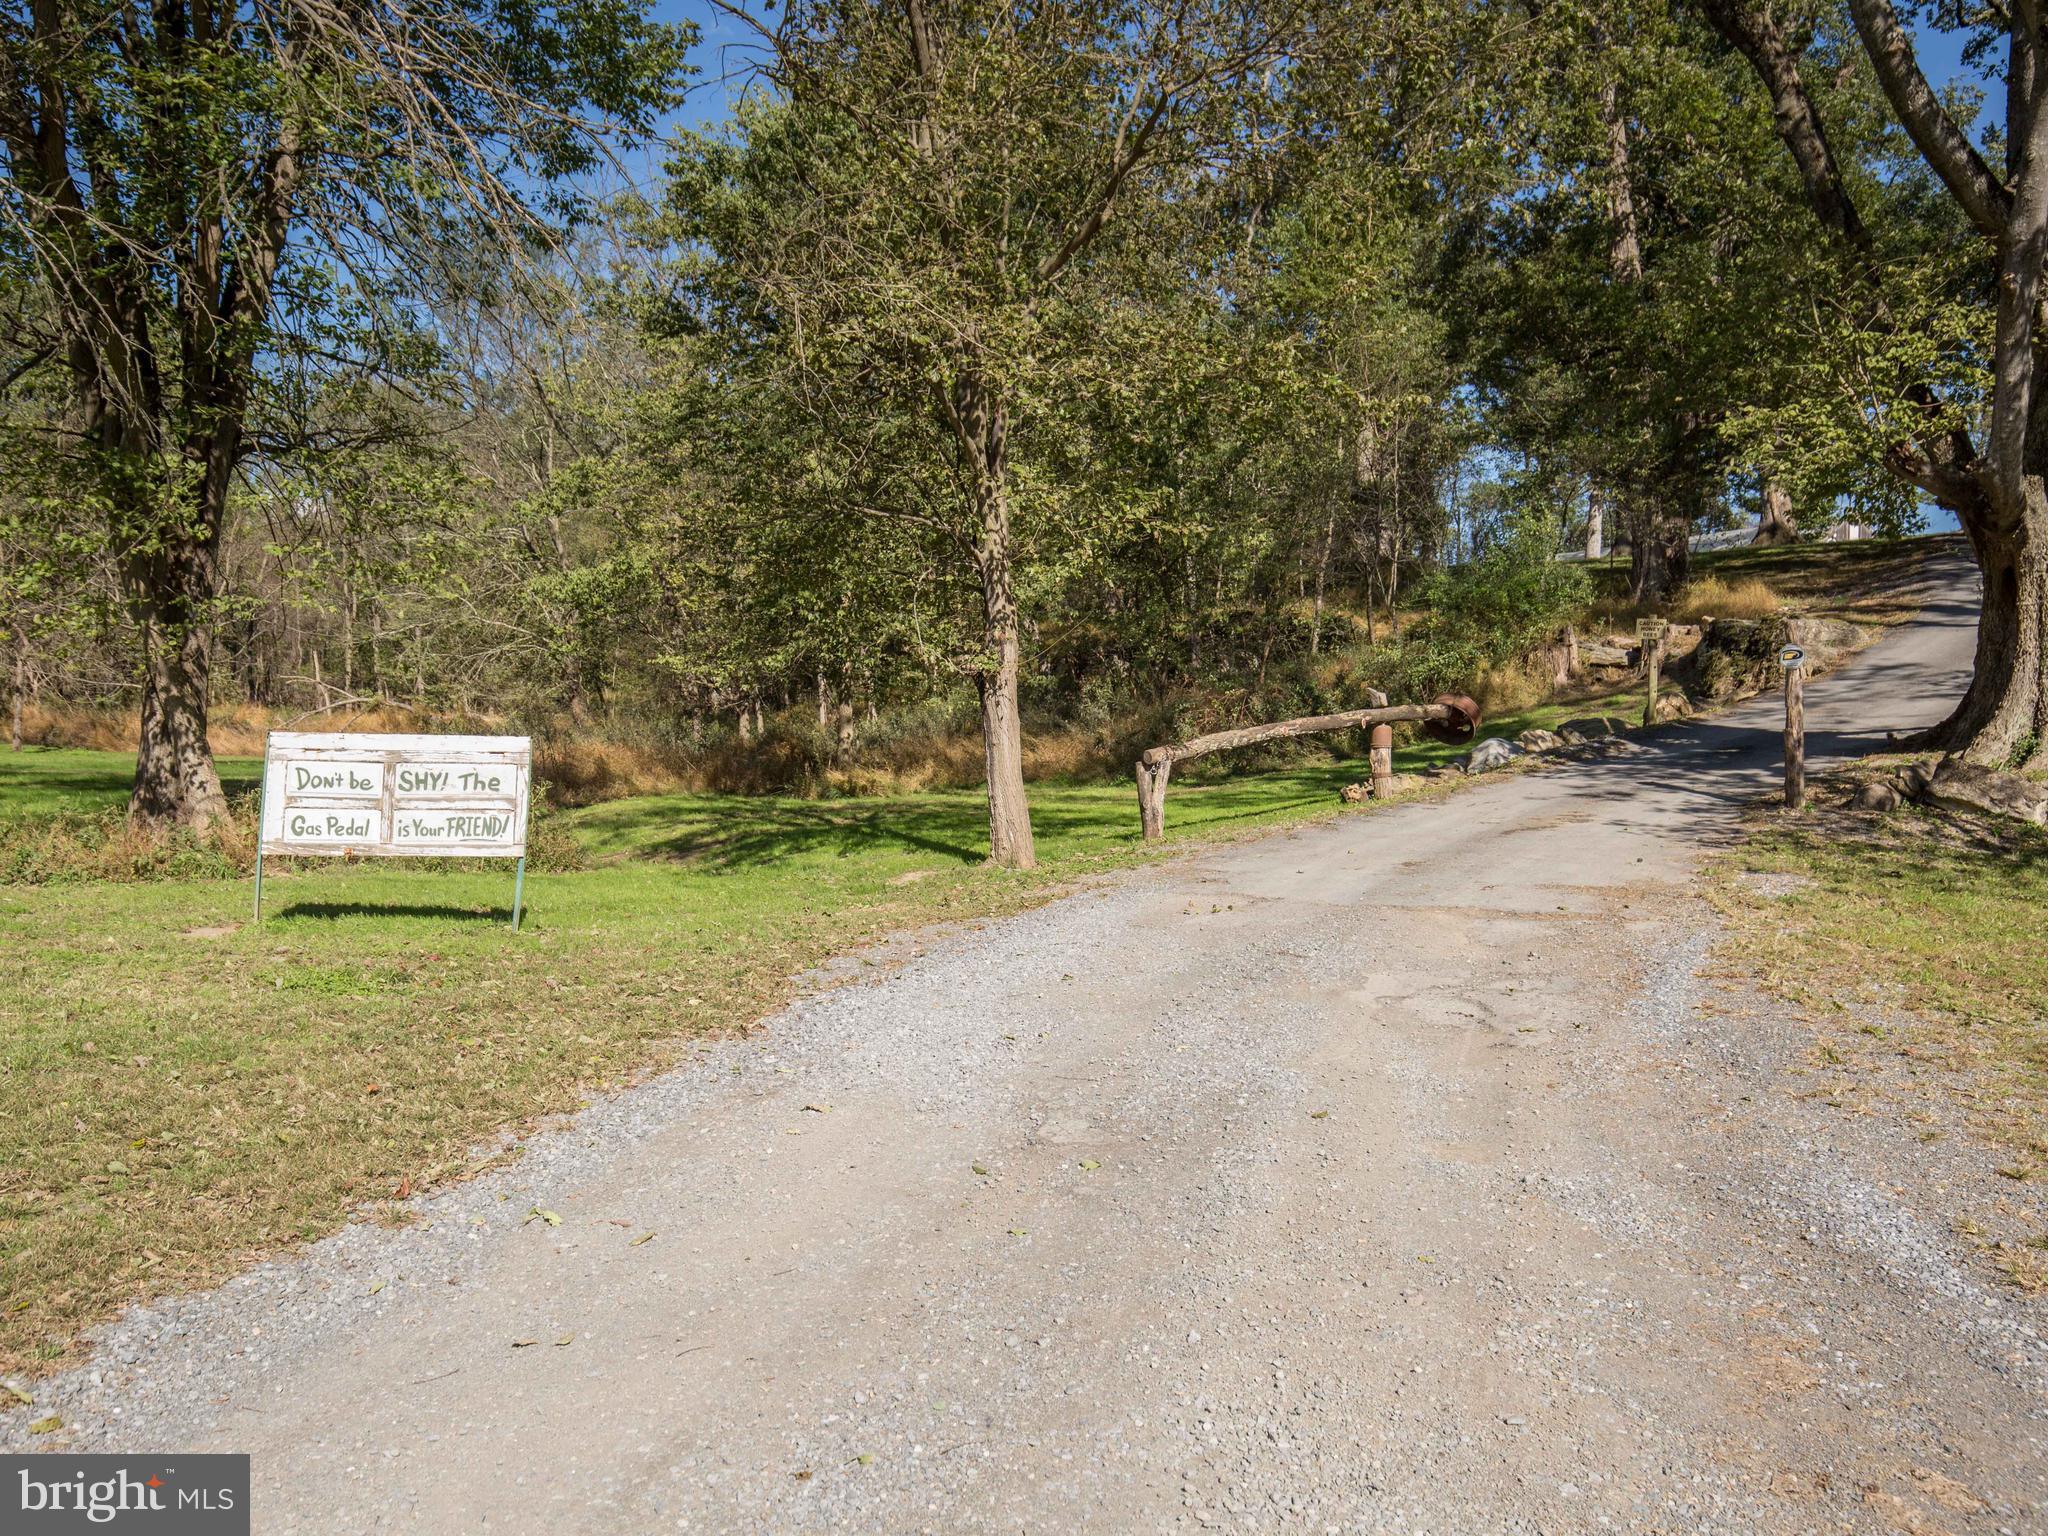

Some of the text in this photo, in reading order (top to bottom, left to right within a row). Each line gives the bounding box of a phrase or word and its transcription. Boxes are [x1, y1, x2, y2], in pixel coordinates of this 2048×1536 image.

[349, 770, 374, 791] be
[398, 770, 449, 792] SHY!
[457, 767, 501, 792] The
[290, 814, 510, 838] Gas Pedal is Your FRIEND!
